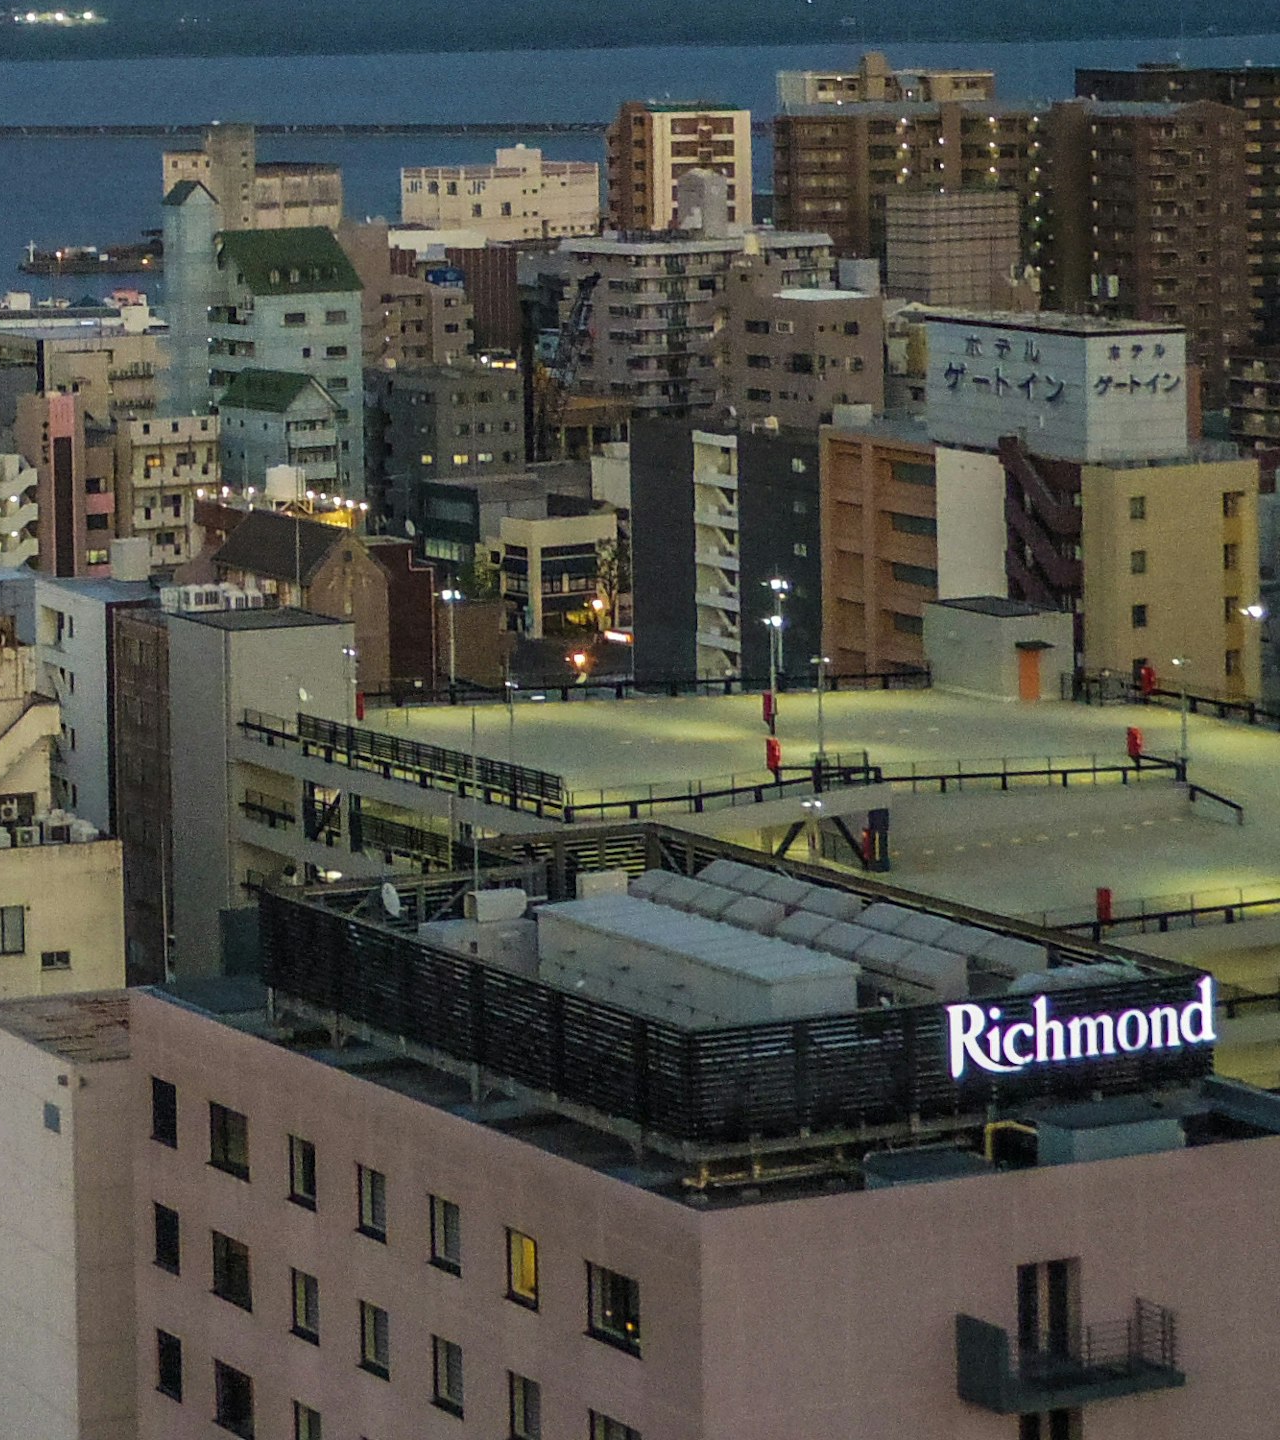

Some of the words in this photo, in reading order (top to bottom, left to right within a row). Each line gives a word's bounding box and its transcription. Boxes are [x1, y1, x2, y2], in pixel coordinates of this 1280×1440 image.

[966, 335, 1040, 361] ホテル
[1109, 343, 1165, 360] ホテル
[944, 362, 1065, 402] ゲートイン
[1094, 372, 1181, 395] ゲートイン
[945, 976, 1217, 1079] Richmond
